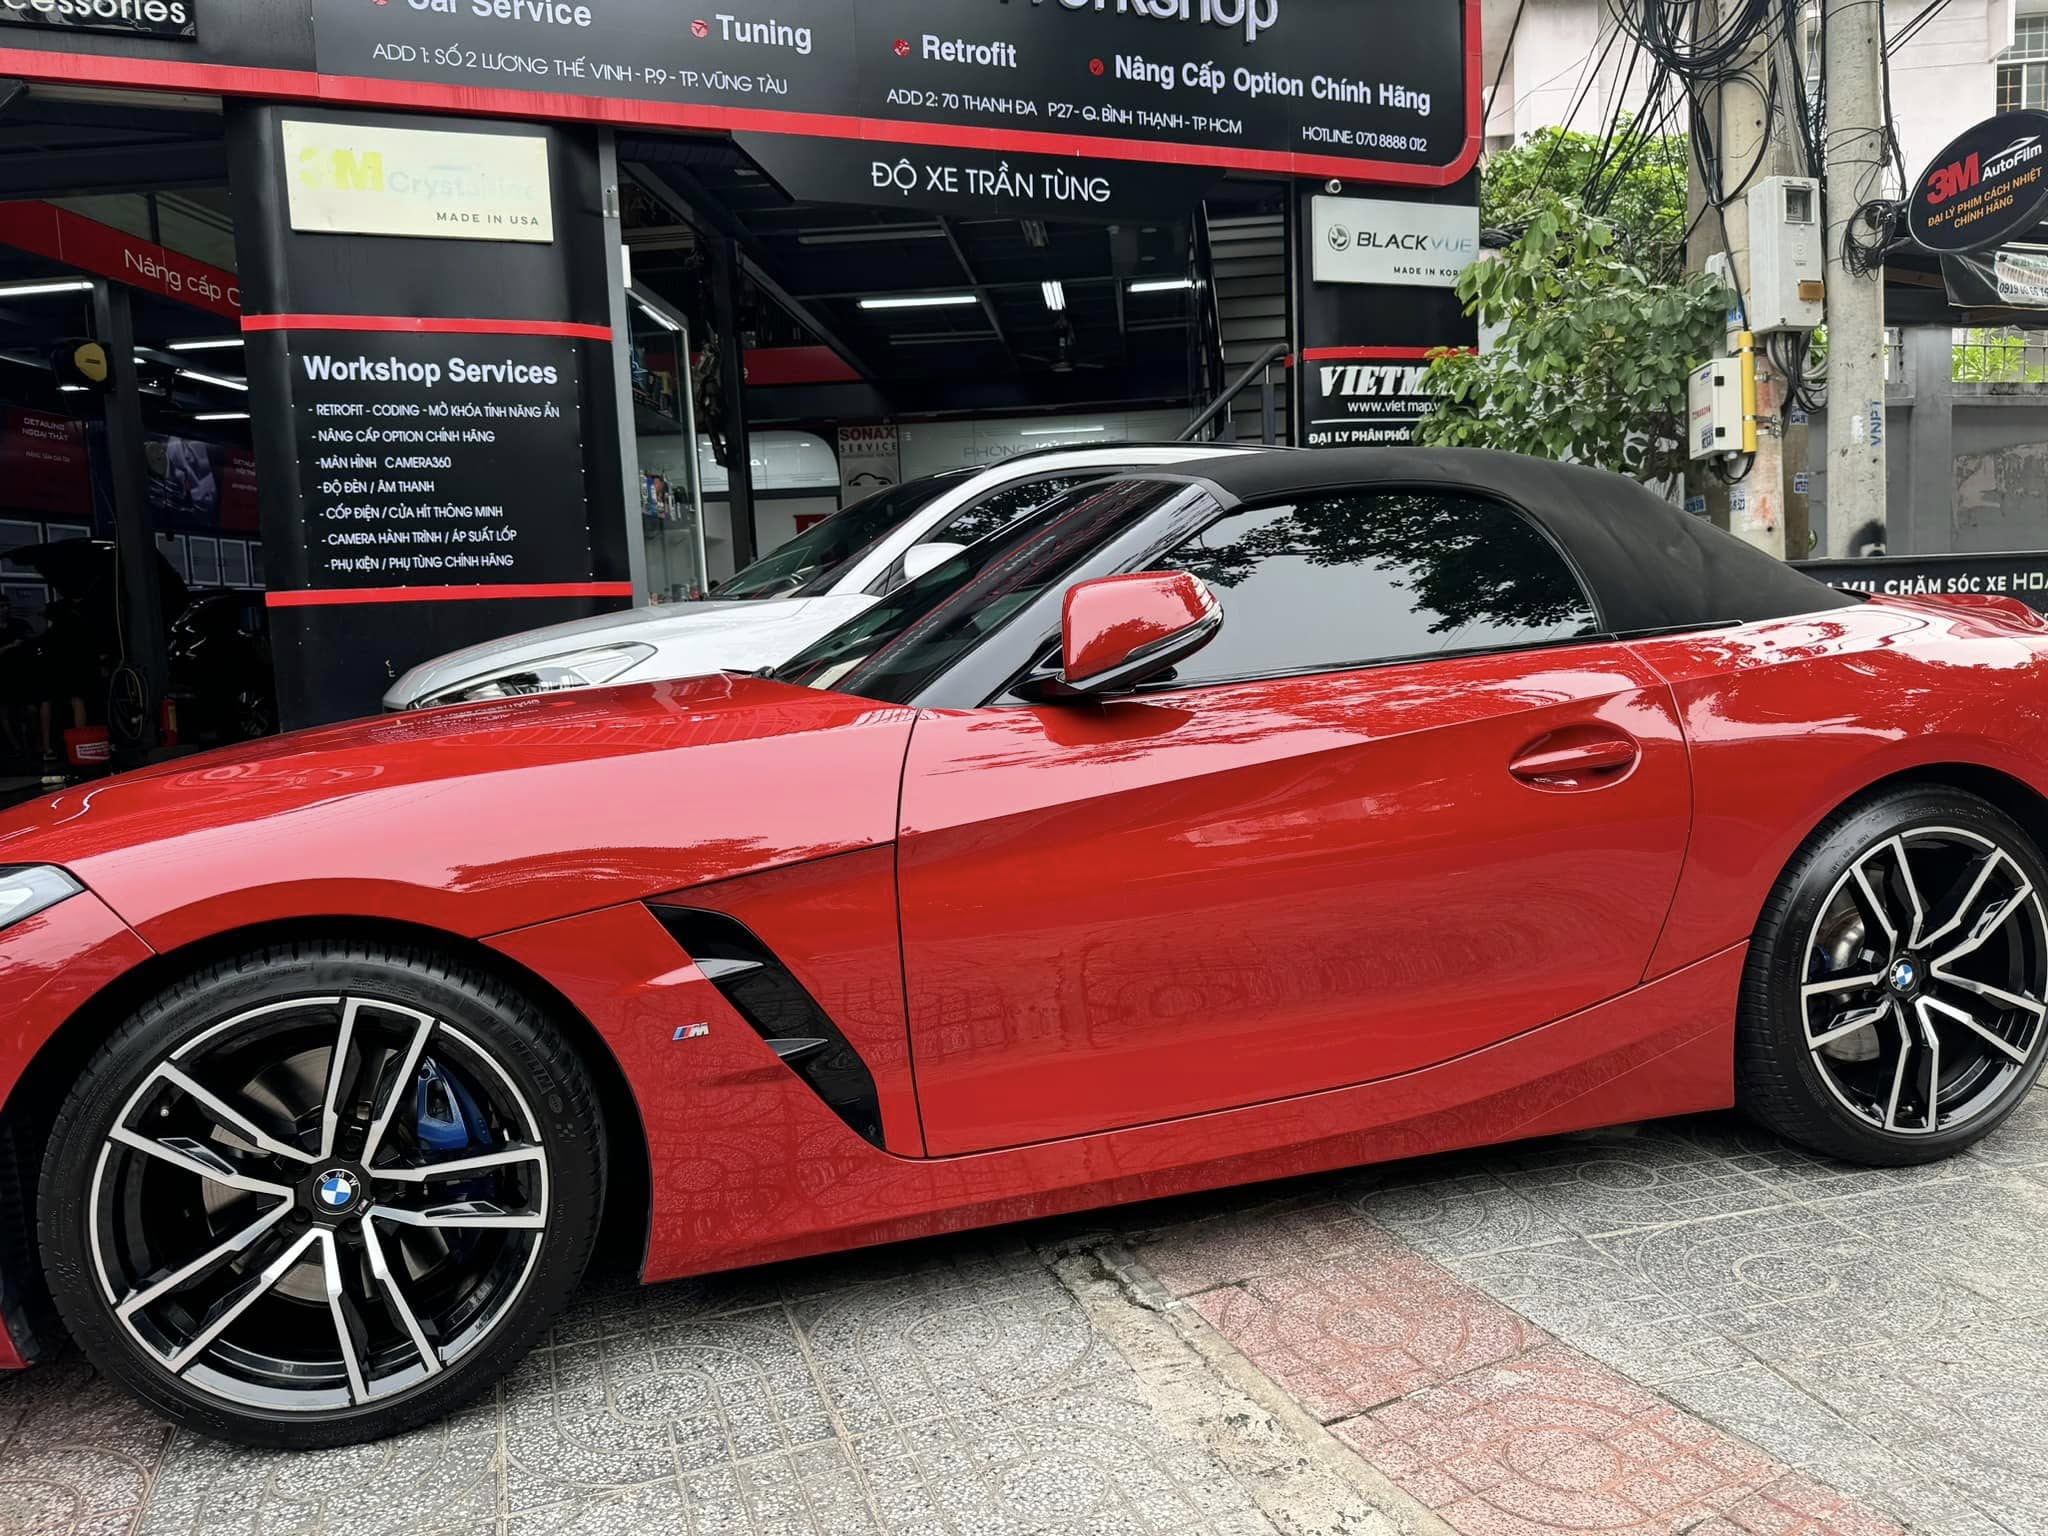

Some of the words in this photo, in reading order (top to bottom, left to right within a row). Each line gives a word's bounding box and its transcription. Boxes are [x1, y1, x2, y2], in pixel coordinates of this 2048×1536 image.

[472, 0, 592, 28] Service
[715, 14, 813, 55] Tuning
[921, 34, 1017, 69] Retrofit
[372, 43, 417, 62] ADD
[435, 43, 463, 67] SỐ
[466, 51, 478, 68] 2
[554, 55, 587, 79] THẾ
[590, 62, 632, 82] VINH
[757, 74, 788, 95] TÀU
[1115, 54, 1175, 90] Nâng
[1181, 60, 1226, 93] Cấp
[1233, 68, 1304, 99] Option
[1311, 75, 1372, 105] Chính
[1379, 83, 1431, 116] Hãng
[886, 88, 923, 106] ADD
[926, 92, 938, 107] 2:
[941, 93, 959, 110] 70
[962, 95, 1013, 115] THANH
[1015, 99, 1038, 116] ĐA
[1102, 104, 1133, 125] BÌNH
[1356, 132, 1378, 147] 070
[1379, 134, 1407, 150] 8888
[1409, 138, 1427, 151] 012
[872, 158, 918, 196] ĐỘ
[926, 165, 959, 193] XE
[965, 160, 1034, 200] TRẦN
[1042, 168, 1111, 203] TÙNG
[1927, 151, 1980, 205] 3M
[1982, 144, 2043, 182] AutoFilm
[1928, 213, 1944, 228] ĐẠI
[1945, 206, 1956, 220] LÝ
[1957, 195, 1982, 214] PHIM
[1984, 181, 2010, 201] CÁCH
[2012, 166, 2043, 189] NHIỆT
[436, 212, 480, 223] MADE
[487, 214, 503, 225] IN
[509, 215, 539, 226] USA
[1954, 207, 1984, 228] CHÍNH
[1986, 194, 2014, 215] HÃNG
[1356, 231, 1473, 254] BLACKVUE
[124, 248, 182, 292] Nâng
[187, 274, 222, 302] cấp
[1393, 266, 1422, 275] MADE
[1425, 268, 1436, 276] IN
[303, 355, 442, 388] Workshop
[448, 357, 559, 385] Services
[1320, 365, 1456, 397] VIETM
[316, 403, 364, 417] RETROFIT
[372, 404, 420, 417] CODING
[451, 401, 482, 417] KHÓA
[508, 404, 542, 418] NĂNG
[318, 427, 353, 443] NÂNG
[355, 426, 381, 443] CẤP
[383, 430, 424, 443] OPTION
[425, 426, 460, 443] CHÍNH
[463, 427, 495, 443] HÃNG
[839, 426, 896, 442] SONAX
[1308, 431, 1332, 446] ĐẠI
[1351, 428, 1384, 442] PHÂN
[1384, 426, 1410, 441] PHỐI
[840, 441, 897, 454] SERVICE
[350, 453, 377, 468] HÌNH
[384, 456, 452, 469] CAMERA360
[322, 479, 342, 496] ĐỘ
[344, 478, 367, 493] ĐÈN
[377, 479, 397, 493] ÂM
[398, 480, 435, 493] THANH
[326, 503, 352, 519] CỐP
[354, 504, 380, 522] ĐIỆN
[434, 502, 473, 518] THÔNG
[475, 505, 503, 517] MINH
[328, 533, 376, 546] CAMERA
[378, 528, 411, 544] HÀNH
[412, 528, 442, 544] TRÌNH
[451, 526, 467, 543] ÁP
[468, 525, 496, 543] SUẤT
[496, 524, 517, 542] LỐP
[330, 558, 354, 572] PHỤ
[355, 556, 380, 572] KIỆN
[388, 558, 411, 572] PHỤ
[412, 554, 443, 569] TÙNG
[445, 553, 479, 568] CHÍNH
[481, 554, 514, 568] HÃNG
[1884, 574, 1941, 595] CHĂM
[1947, 573, 1981, 594] SÓC
[1985, 575, 2007, 592] XE
[319, 1171, 360, 1187] BMW
